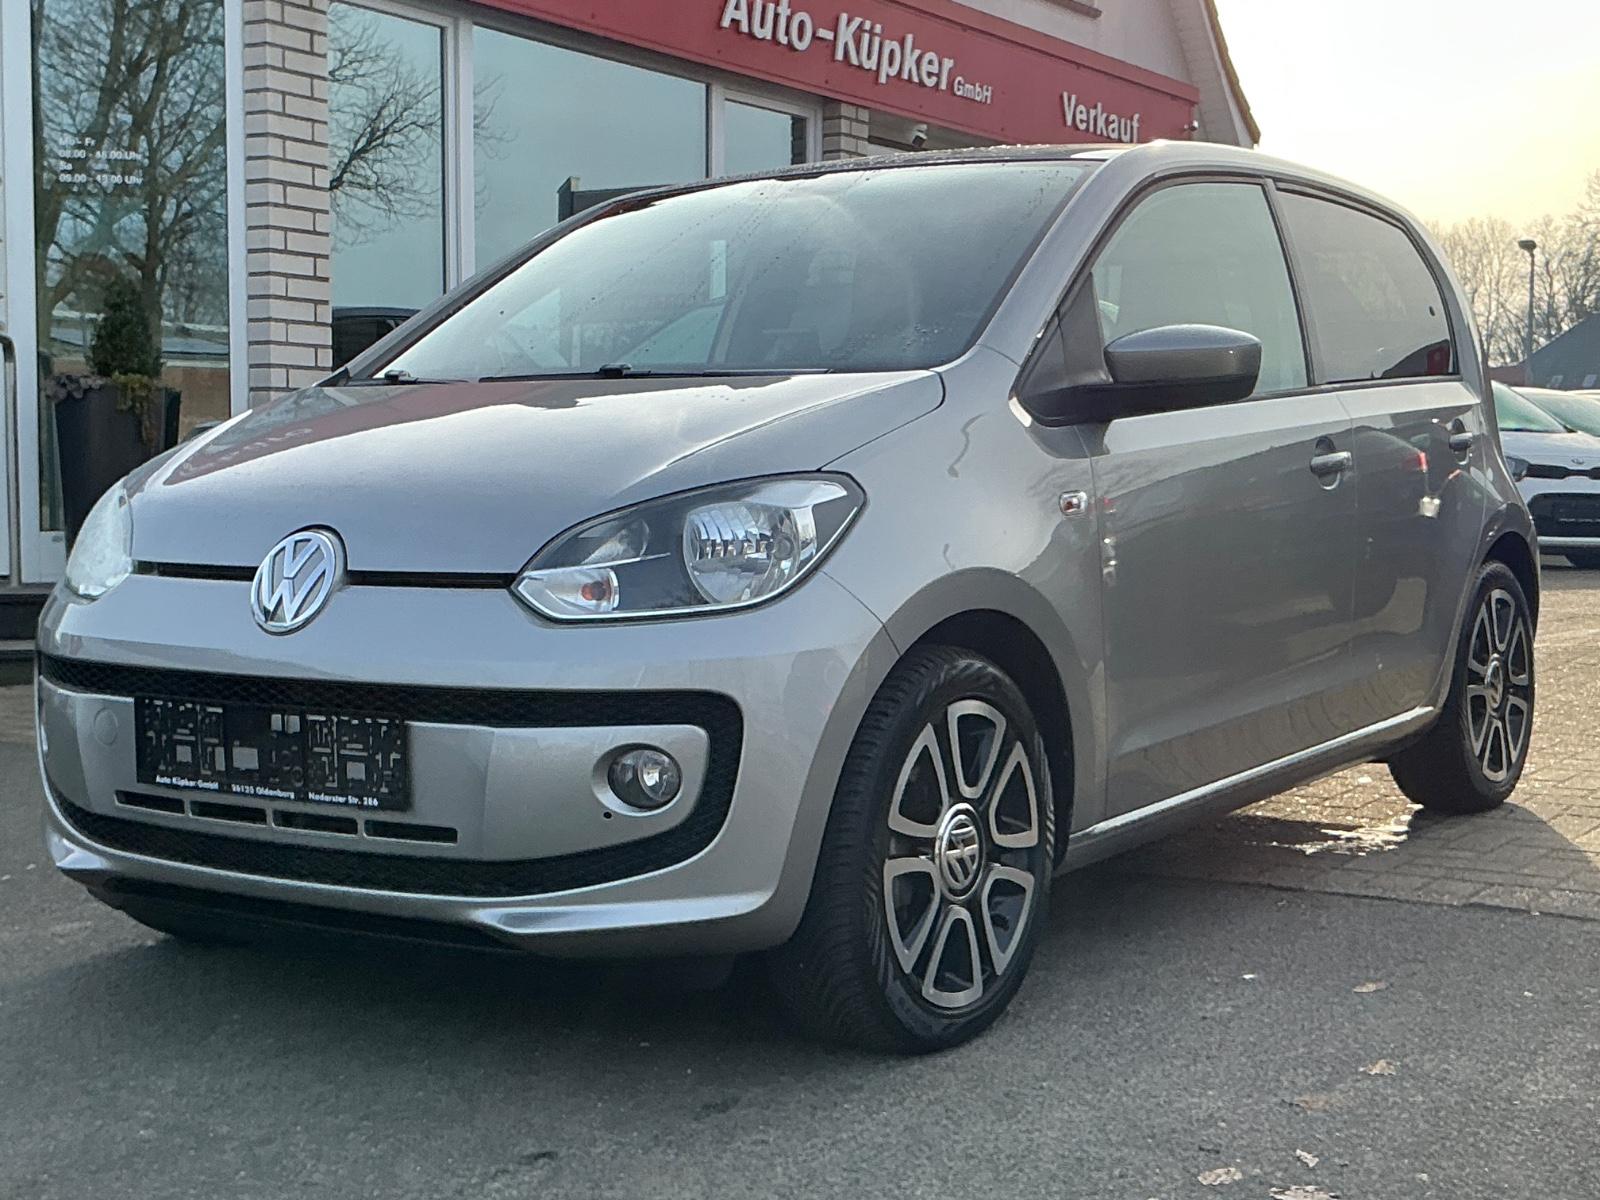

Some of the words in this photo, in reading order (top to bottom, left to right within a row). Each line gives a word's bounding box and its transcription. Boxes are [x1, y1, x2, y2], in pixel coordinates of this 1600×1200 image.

[720, 0, 953, 90] Auto-Küpker
[954, 76, 992, 104] GmbH
[1063, 91, 1140, 143] Verkauf
